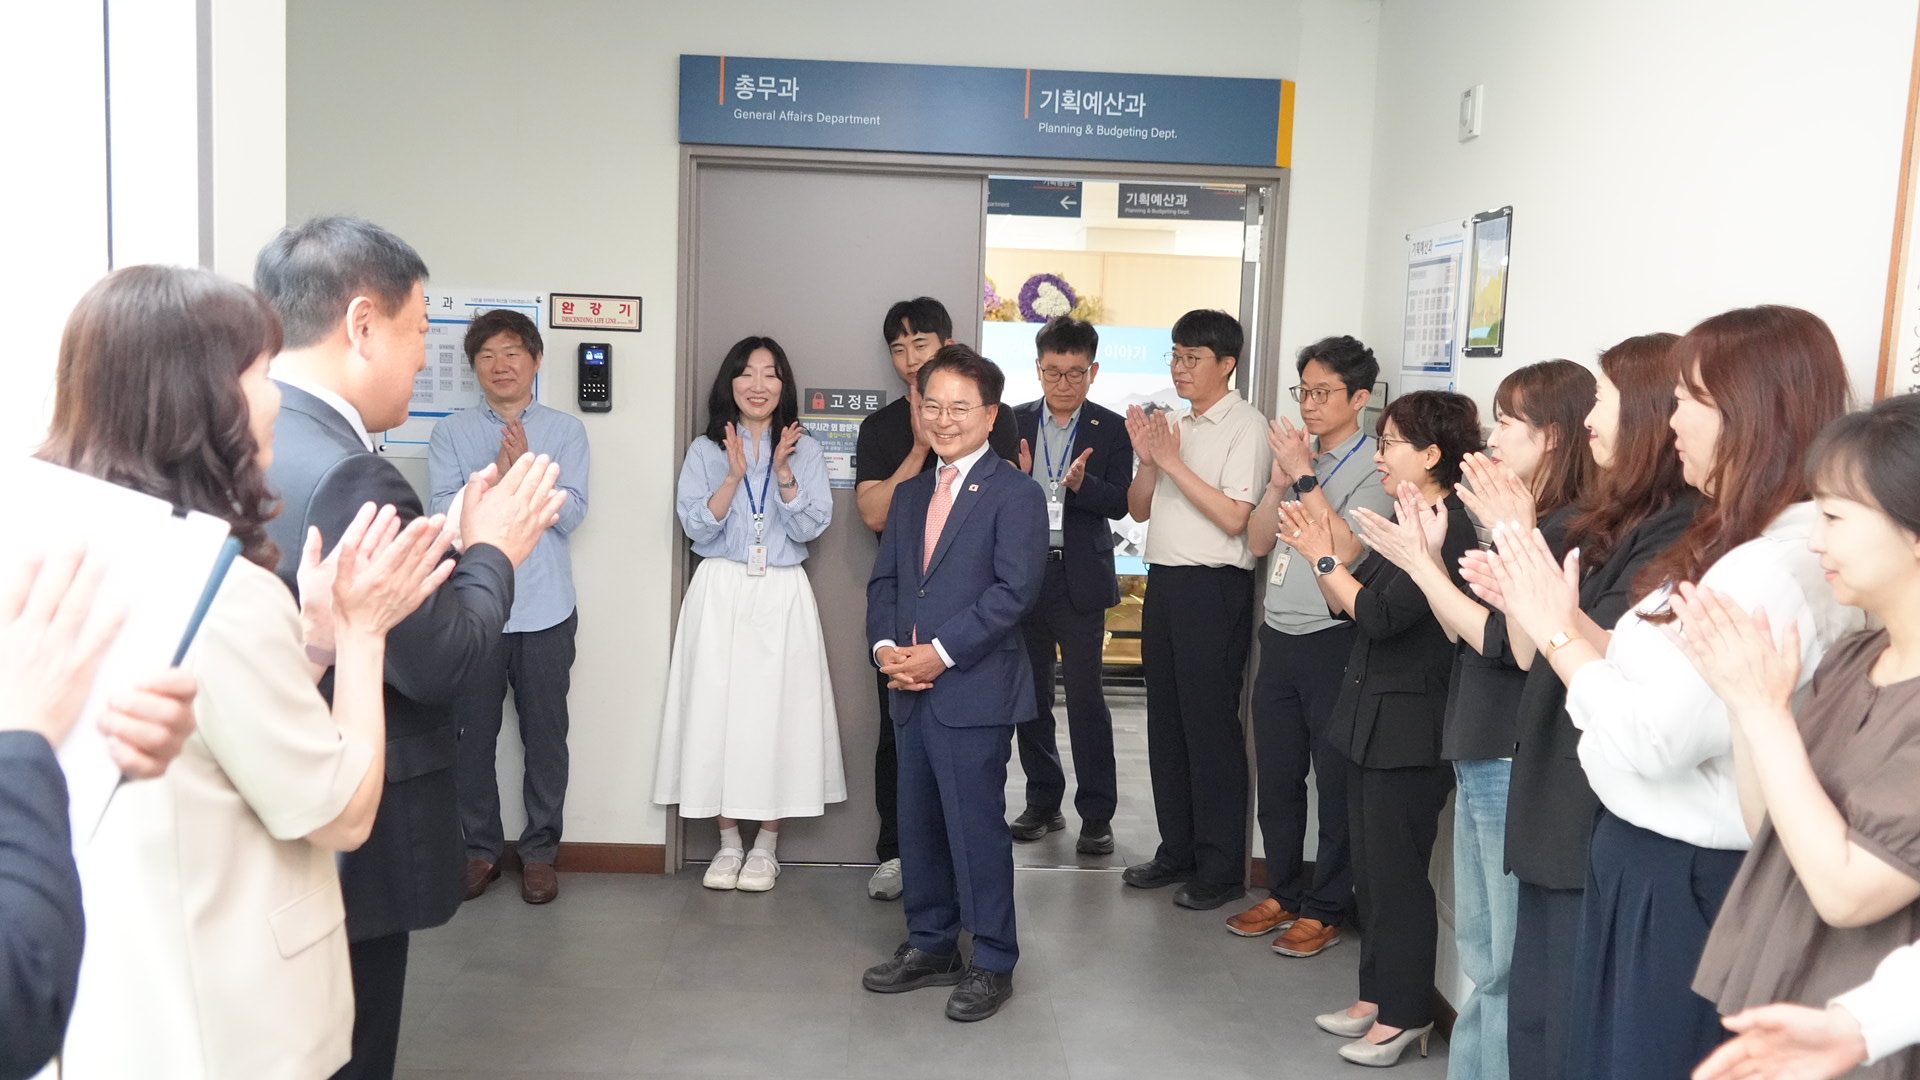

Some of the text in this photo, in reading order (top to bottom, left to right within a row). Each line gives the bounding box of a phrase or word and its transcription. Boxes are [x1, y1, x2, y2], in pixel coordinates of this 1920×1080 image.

[734, 74, 800, 102] 총무과
[1039, 88, 1147, 119] 기획예산과
[733, 108, 881, 126] General Affairs Department
[1038, 122, 1178, 142] Planning & Budgeting Dept.
[1126, 192, 1188, 208] 기획예산과
[1125, 207, 1146, 215] Planning
[1152, 208, 1177, 217] Budgeting
[1177, 209, 1191, 217] Dept.
[561, 315, 593, 325] DESCENDING
[594, 317, 605, 325] LIFE
[605, 318, 617, 326] LINE
[1104, 344, 1147, 361] 이야기
[830, 394, 879, 411] 고정문
